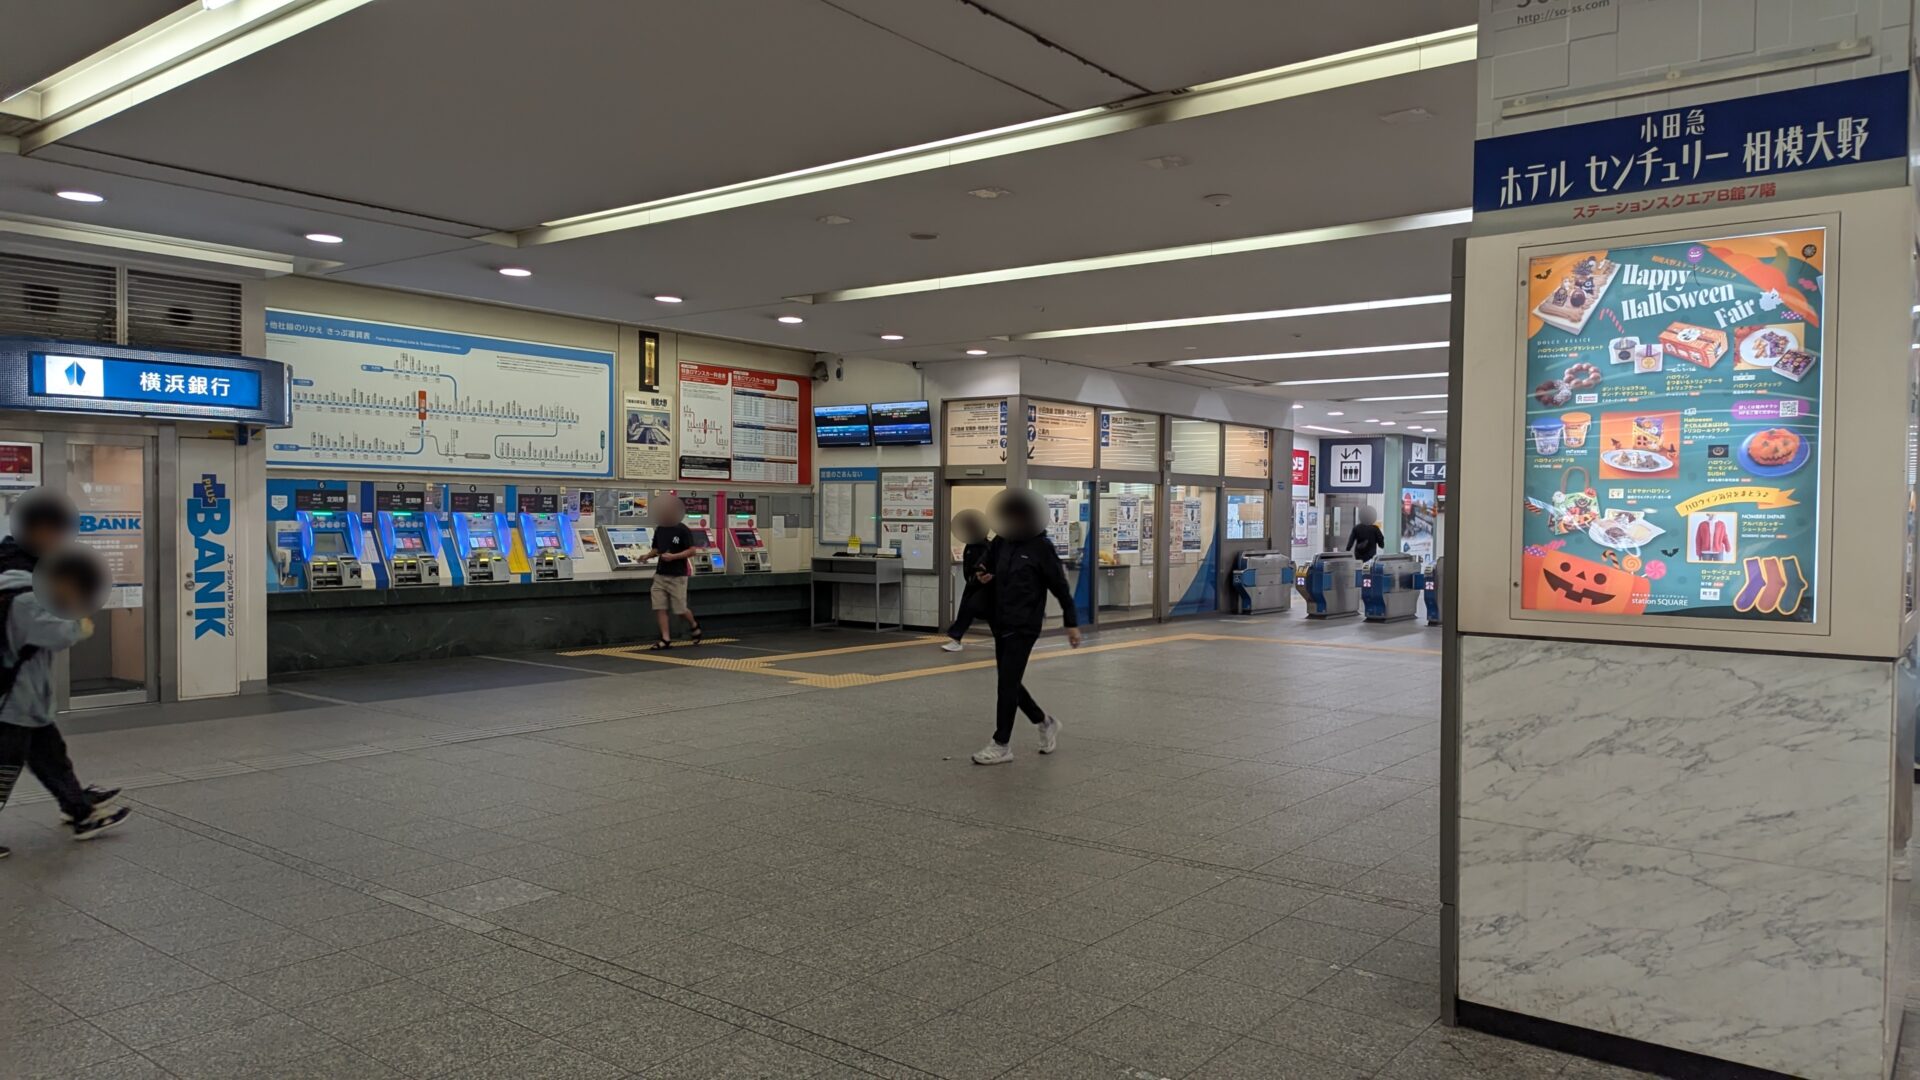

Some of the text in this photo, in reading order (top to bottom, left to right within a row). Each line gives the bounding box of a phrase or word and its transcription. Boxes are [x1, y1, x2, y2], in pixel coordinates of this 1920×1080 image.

[1640, 109, 1705, 143] 小田急
[1500, 117, 1870, 208] ホテル センチュリー 相模大野
[1573, 182, 1777, 221] ステーションスクエアB館7階
[1621, 263, 1692, 291] Happy
[1620, 283, 1736, 322] Halloween
[1713, 297, 1755, 329] Fair
[139, 372, 231, 397] 横浜銀行
[203, 478, 216, 504] PLUS
[79, 514, 141, 532] BANK
[186, 498, 231, 641] BANK
[1631, 598, 1689, 607] station SQUARE
